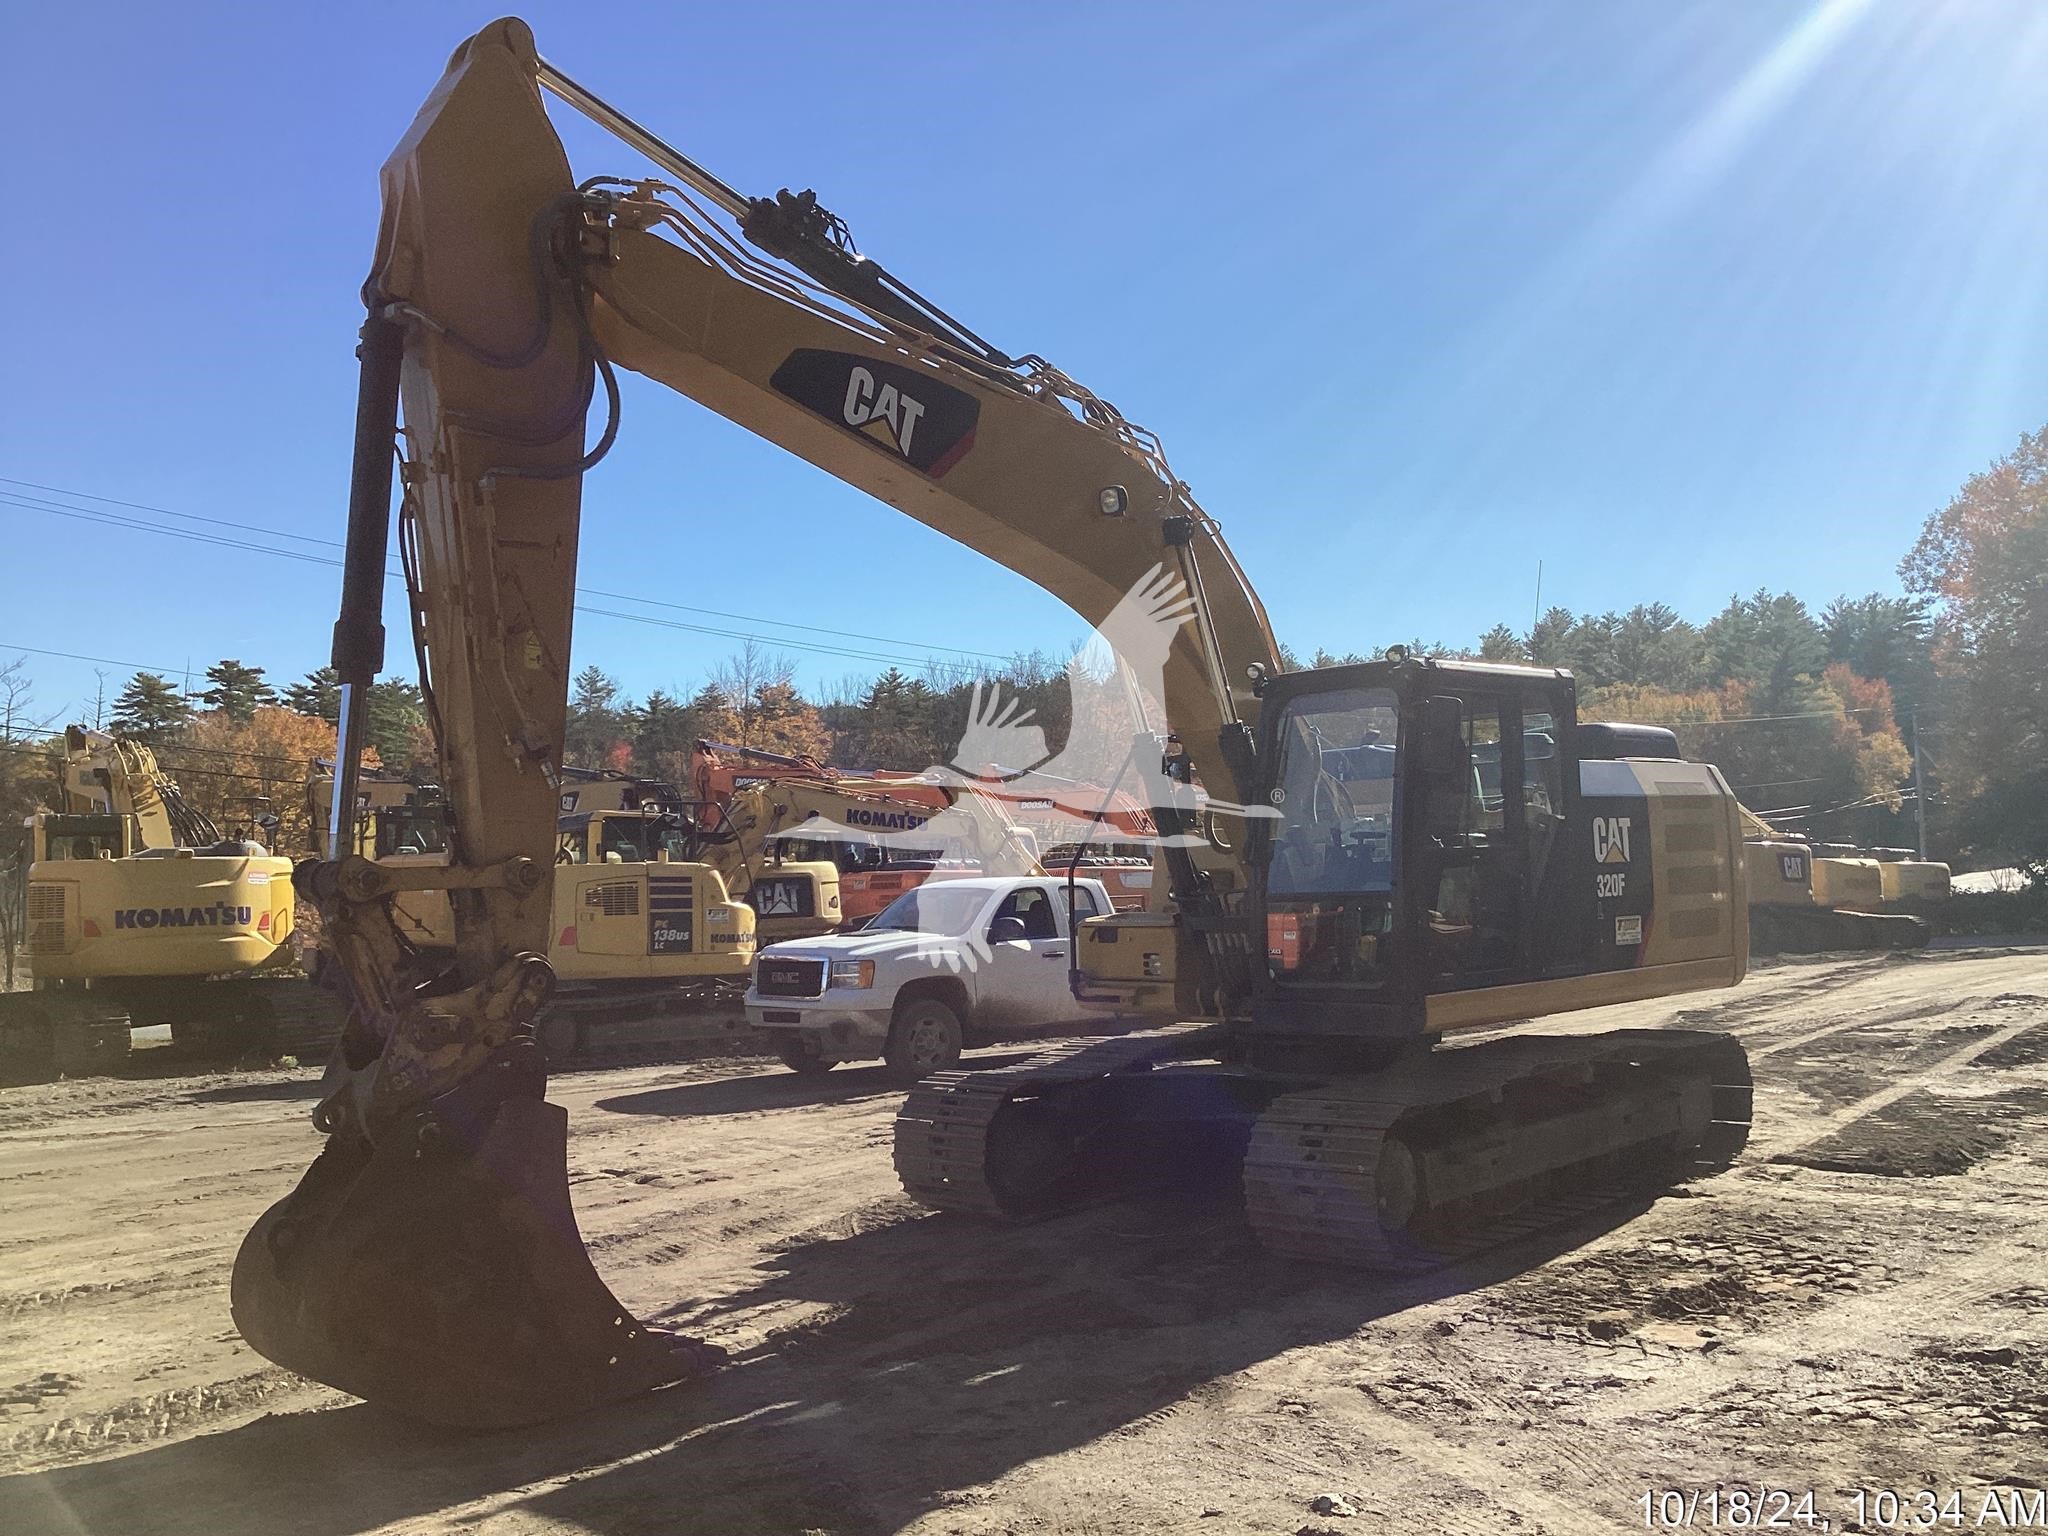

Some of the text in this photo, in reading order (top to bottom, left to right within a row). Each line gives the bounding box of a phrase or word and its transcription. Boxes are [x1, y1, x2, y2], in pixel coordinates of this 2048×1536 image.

[843, 366, 925, 457] CAT
[1020, 800, 1054, 809] DOOSAN
[846, 808, 929, 832] KOMATSU
[1592, 816, 1631, 863] CAT
[1783, 856, 1803, 879] CAT
[757, 882, 800, 915] CAT
[1596, 873, 1625, 898] 320F
[115, 901, 252, 929] KOMATSU
